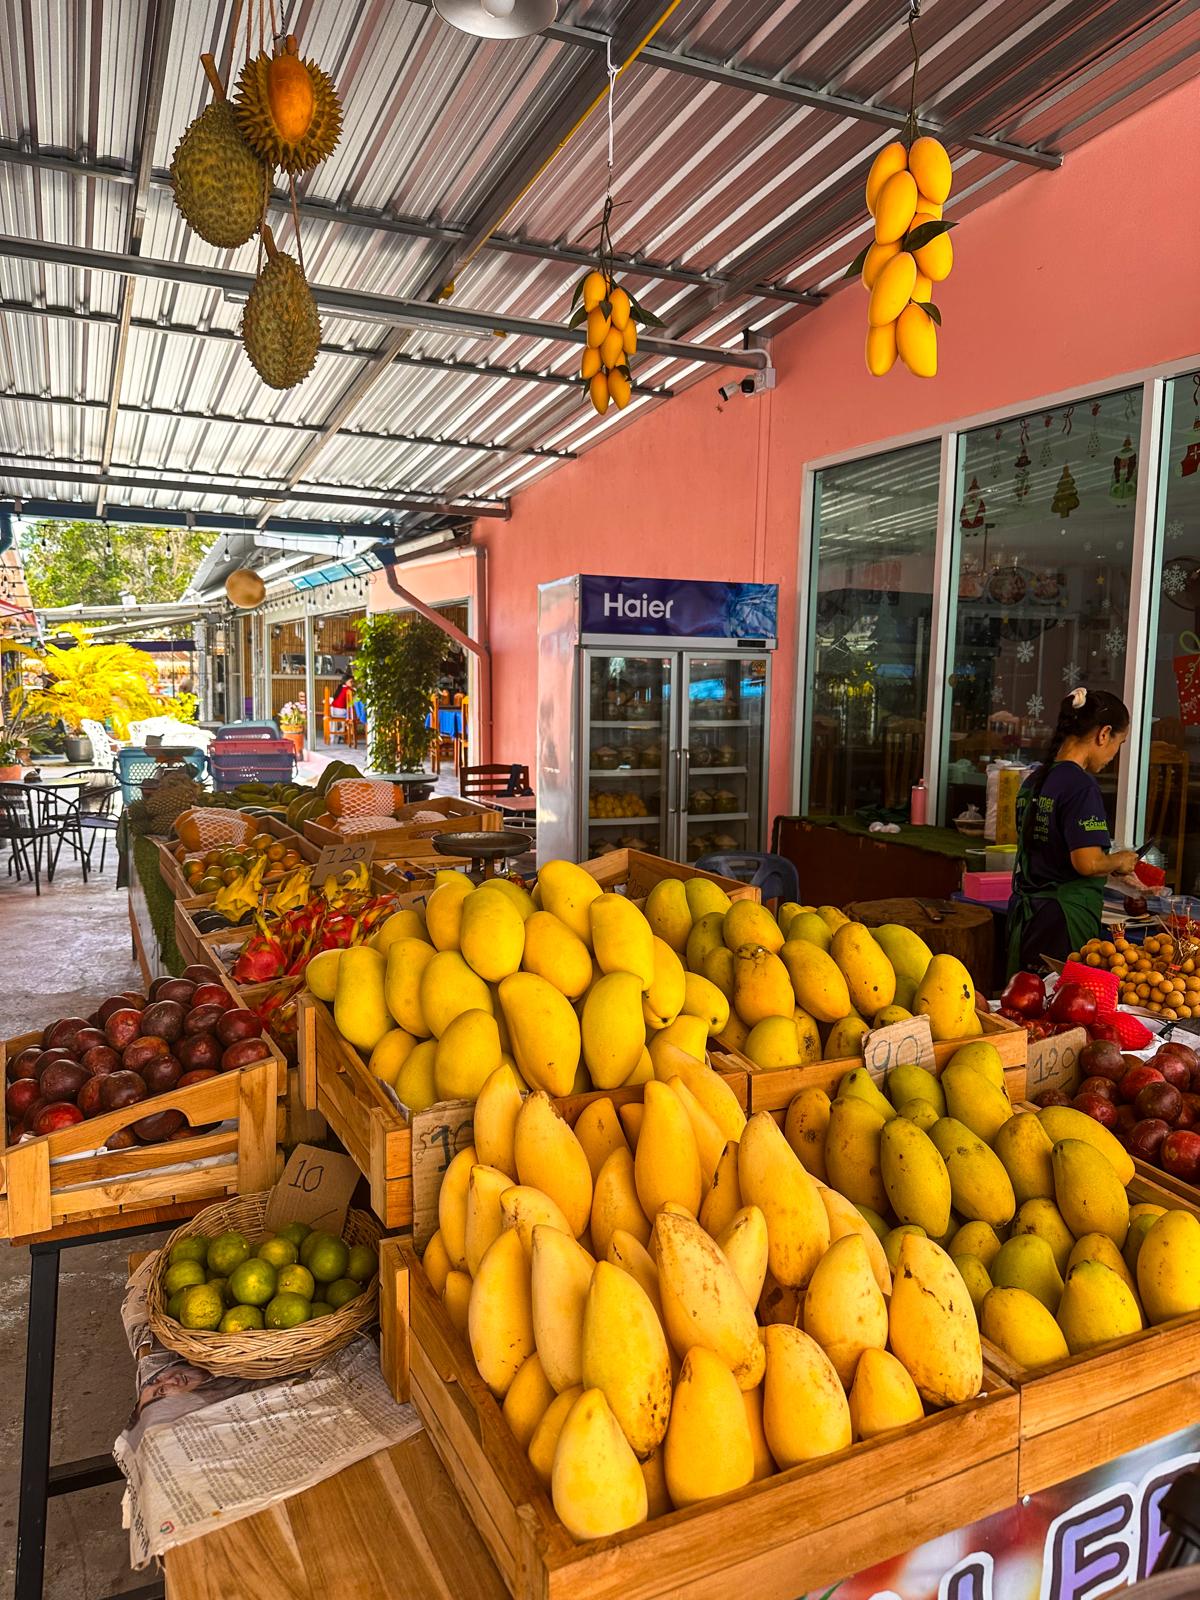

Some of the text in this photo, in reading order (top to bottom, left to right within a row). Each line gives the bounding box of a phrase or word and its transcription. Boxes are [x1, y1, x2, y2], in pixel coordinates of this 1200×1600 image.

[604, 592, 673, 618] Haier
[325, 846, 367, 865] 120
[1033, 1046, 1076, 1084] 120
[288, 1159, 325, 1193] 10
